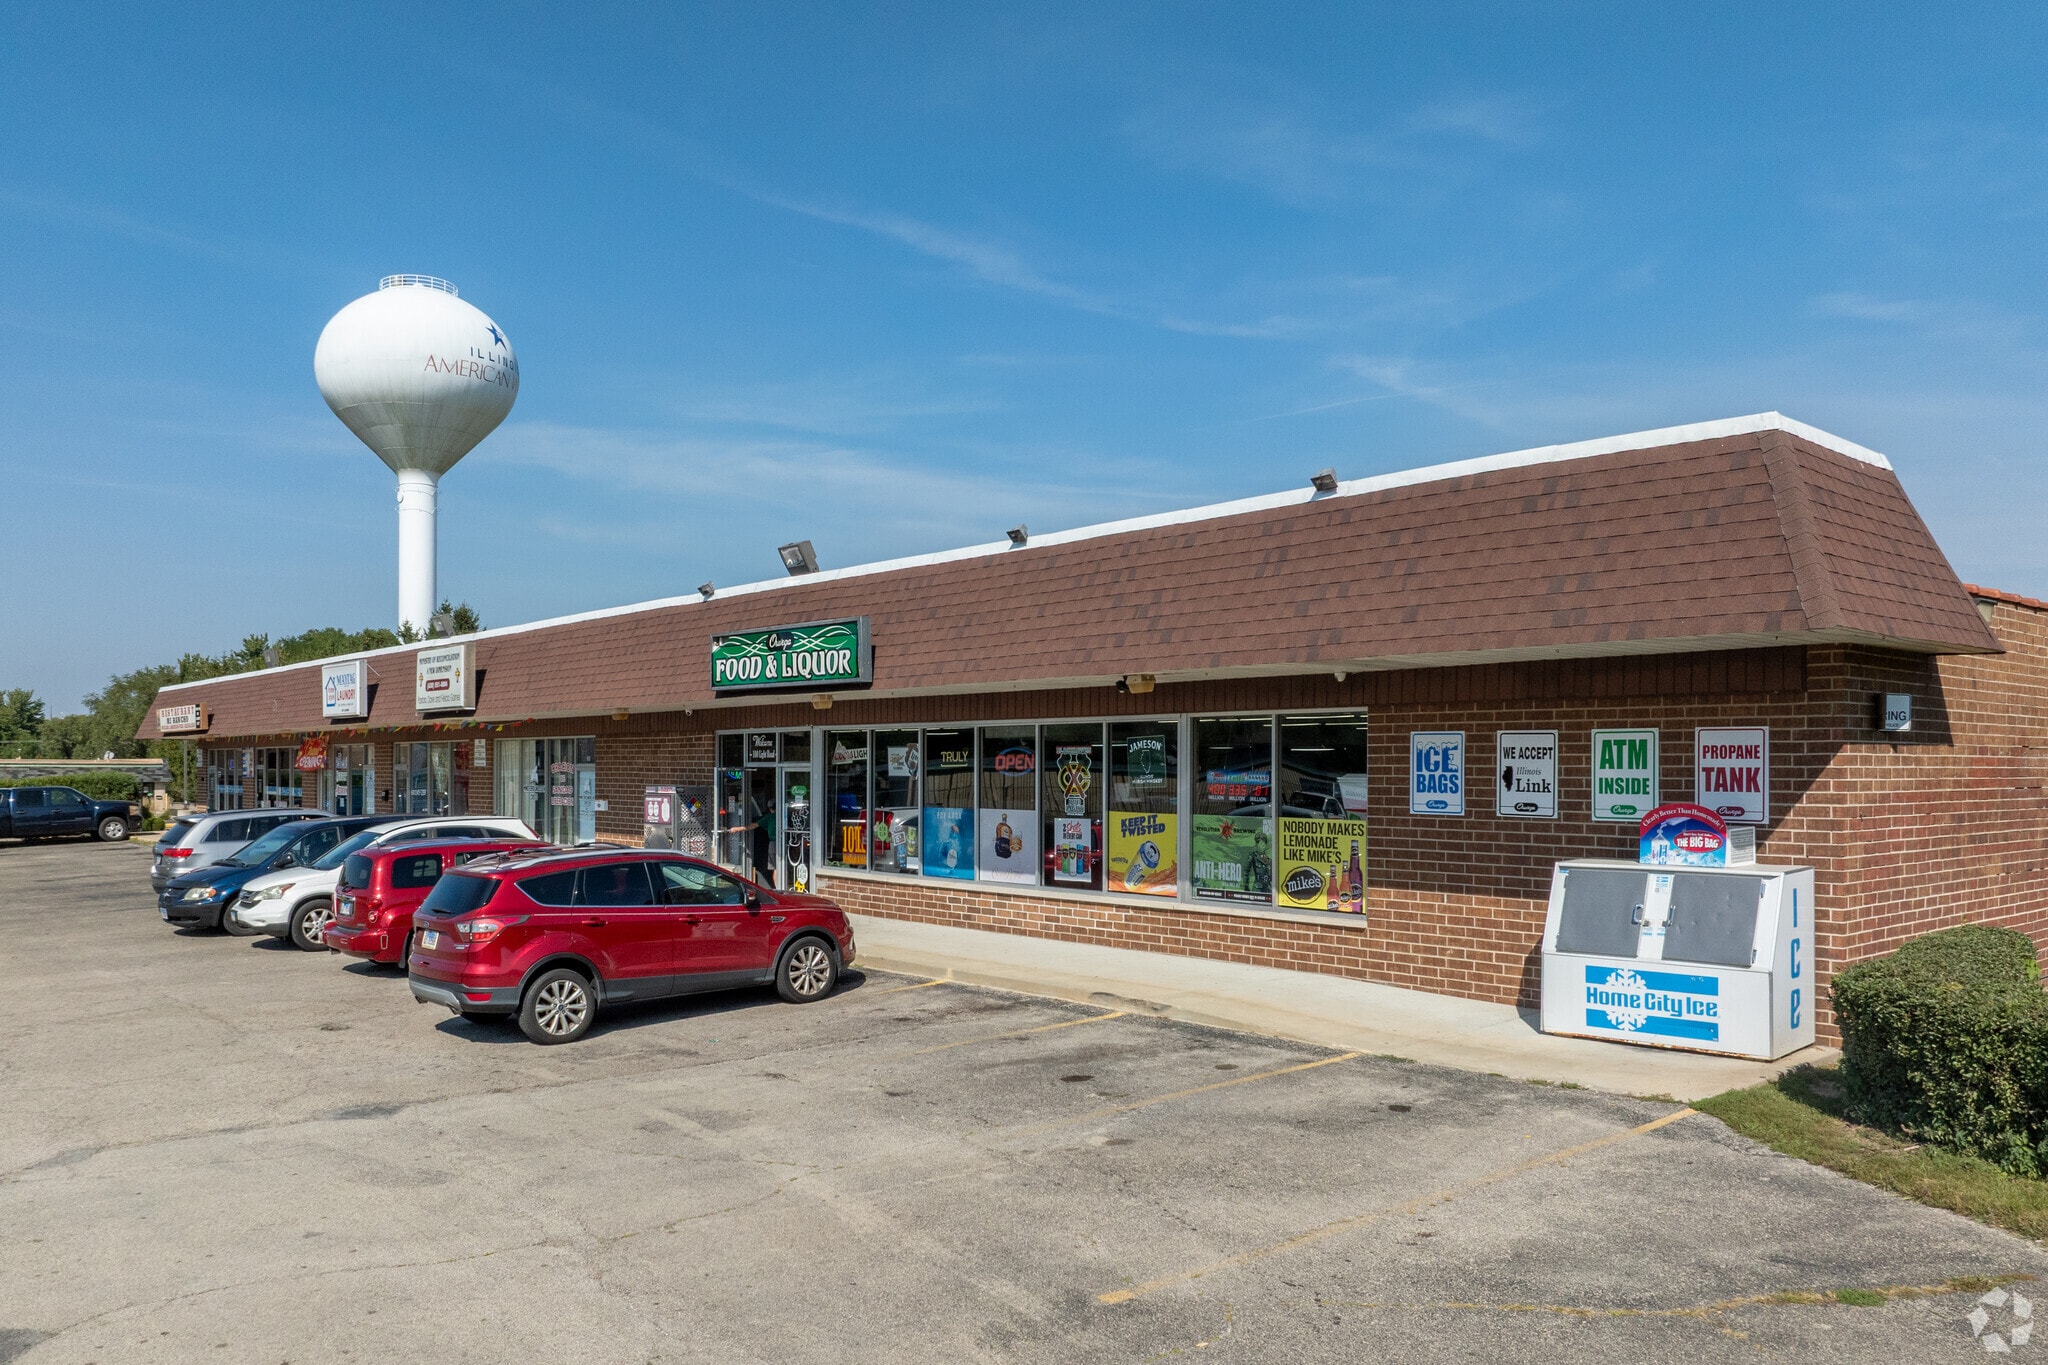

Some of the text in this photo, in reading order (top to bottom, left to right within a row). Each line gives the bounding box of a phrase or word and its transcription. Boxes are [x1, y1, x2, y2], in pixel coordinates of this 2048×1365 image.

[423, 354, 510, 388] AMERICAN
[716, 649, 851, 681] FOOD & LIQUOR
[337, 689, 355, 700] LAUNDRY
[853, 749, 867, 758] LIGH
[1129, 740, 1161, 753] JAMESON
[1503, 746, 1553, 760] WE ACCEPT
[1702, 745, 1760, 760] PROPANE
[940, 751, 968, 762] TRULY
[1416, 741, 1458, 773] ICE
[1600, 739, 1648, 770] ATM
[995, 754, 1034, 771] OPEN
[1516, 767, 1542, 776] Illinois
[1416, 773, 1459, 794] BAGS
[1515, 778, 1551, 793] Link
[1599, 777, 1650, 795] INSIDE
[1702, 767, 1761, 793] TANK
[1121, 815, 1157, 828] KEEP IT
[1642, 813, 1660, 827] Clearly
[1660, 809, 1676, 818] Better
[1121, 823, 1165, 838] TWISTED
[1284, 821, 1324, 834] NOBODY
[1327, 823, 1364, 836] MAKES
[1284, 835, 1338, 849] LEMONADE
[1677, 837, 1719, 849] THE BIG BAG
[1284, 848, 1342, 863] LIKE MIKE'S
[1195, 861, 1241, 881] ANTI-HERO
[1287, 876, 1322, 893] mike's
[1587, 986, 1718, 1017] Home City Ice
